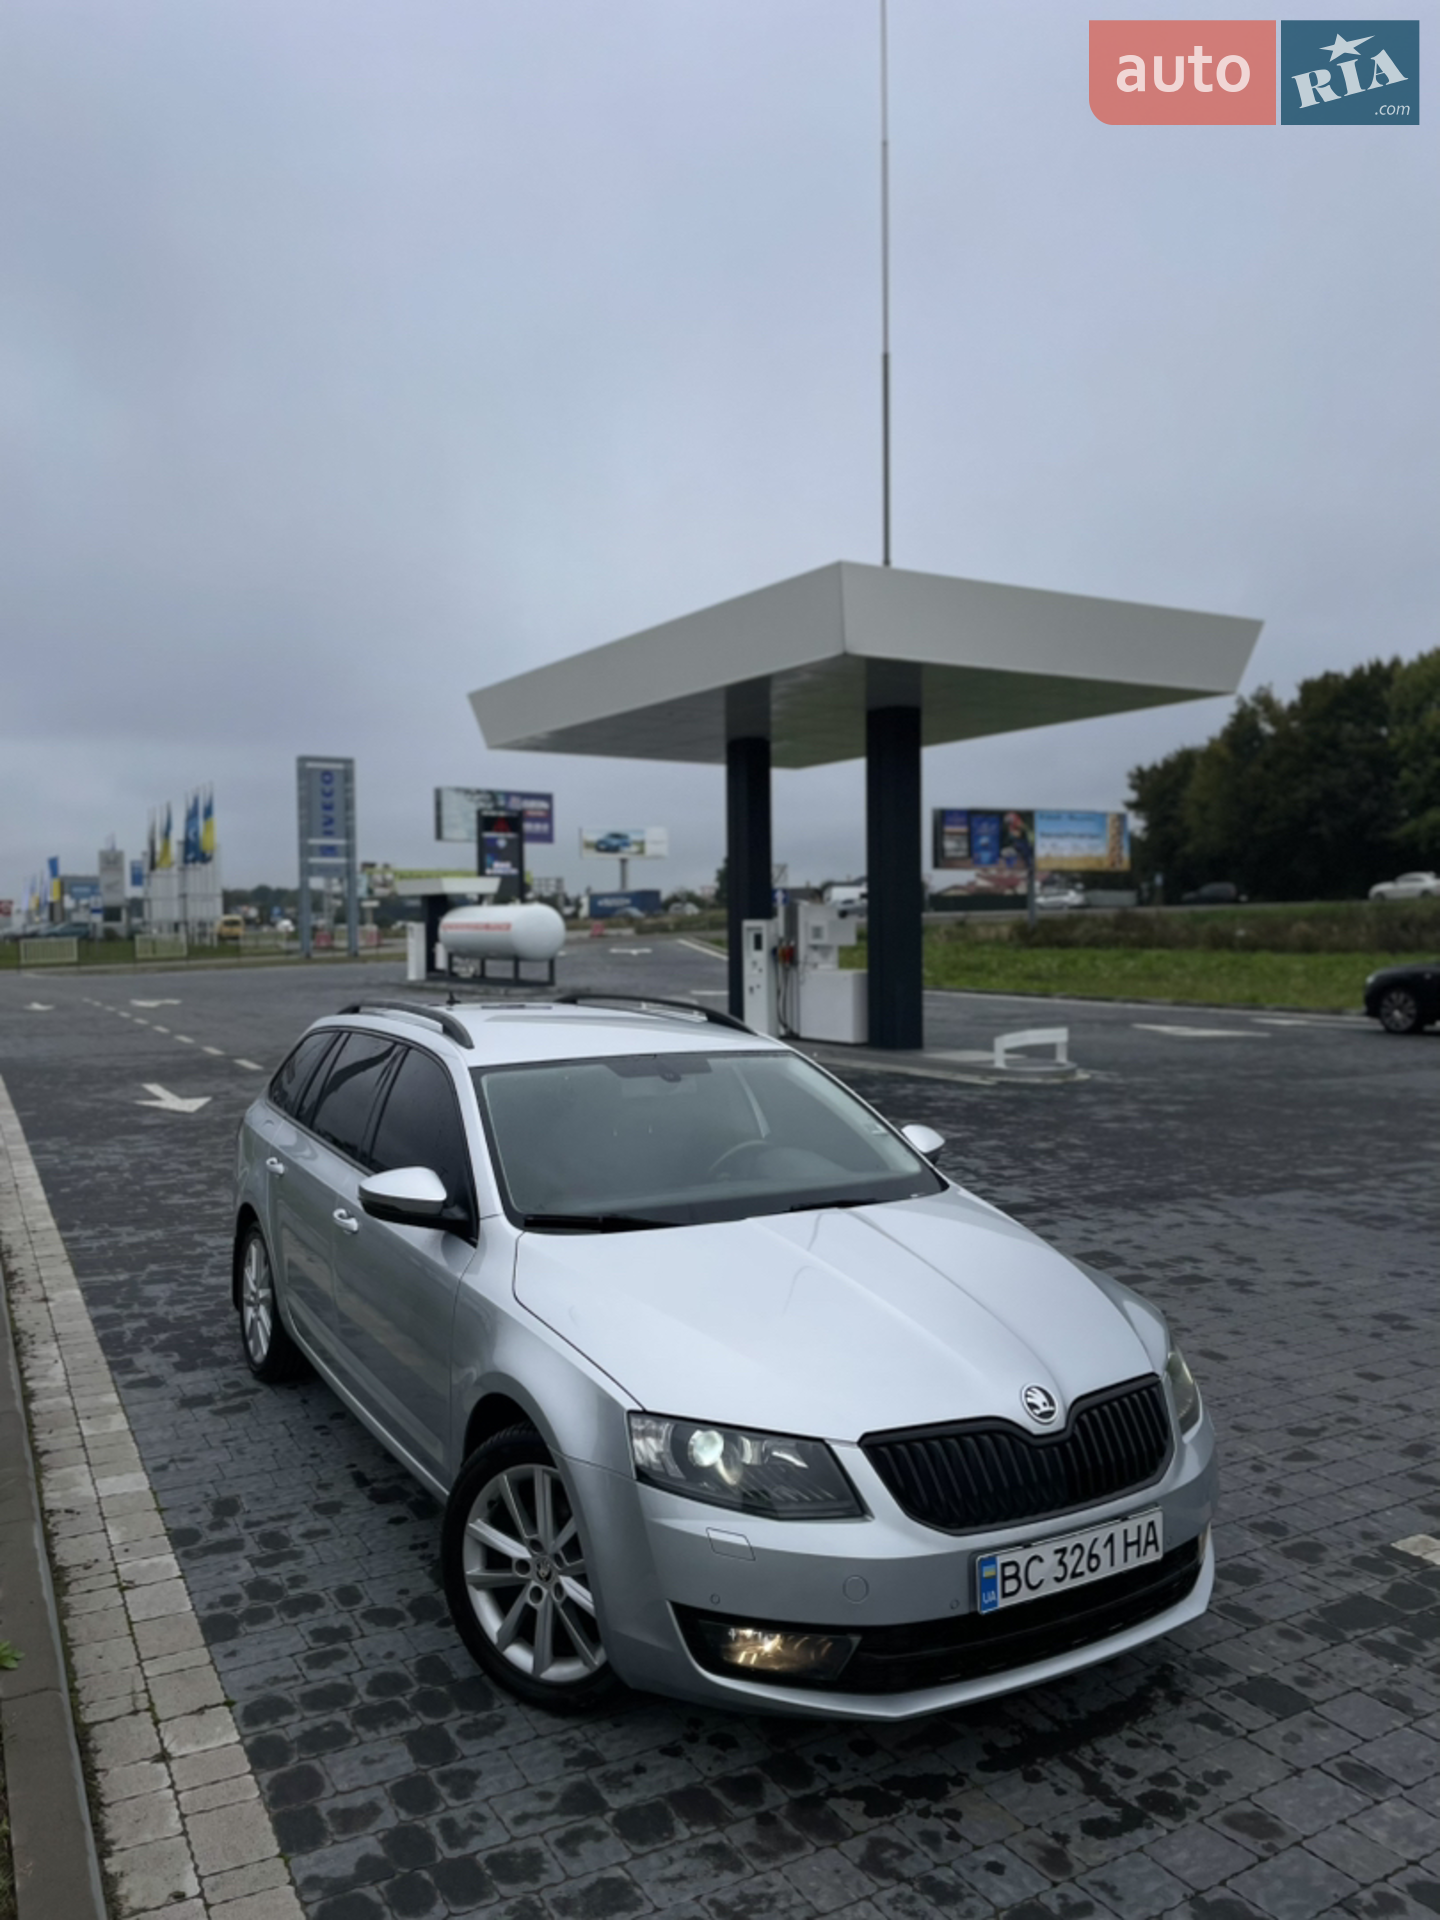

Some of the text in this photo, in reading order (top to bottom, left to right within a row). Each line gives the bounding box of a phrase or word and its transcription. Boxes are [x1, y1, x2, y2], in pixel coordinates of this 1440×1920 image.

[321, 770, 334, 836] IVECO
[1001, 1520, 1159, 1599] BC 3261 HA
